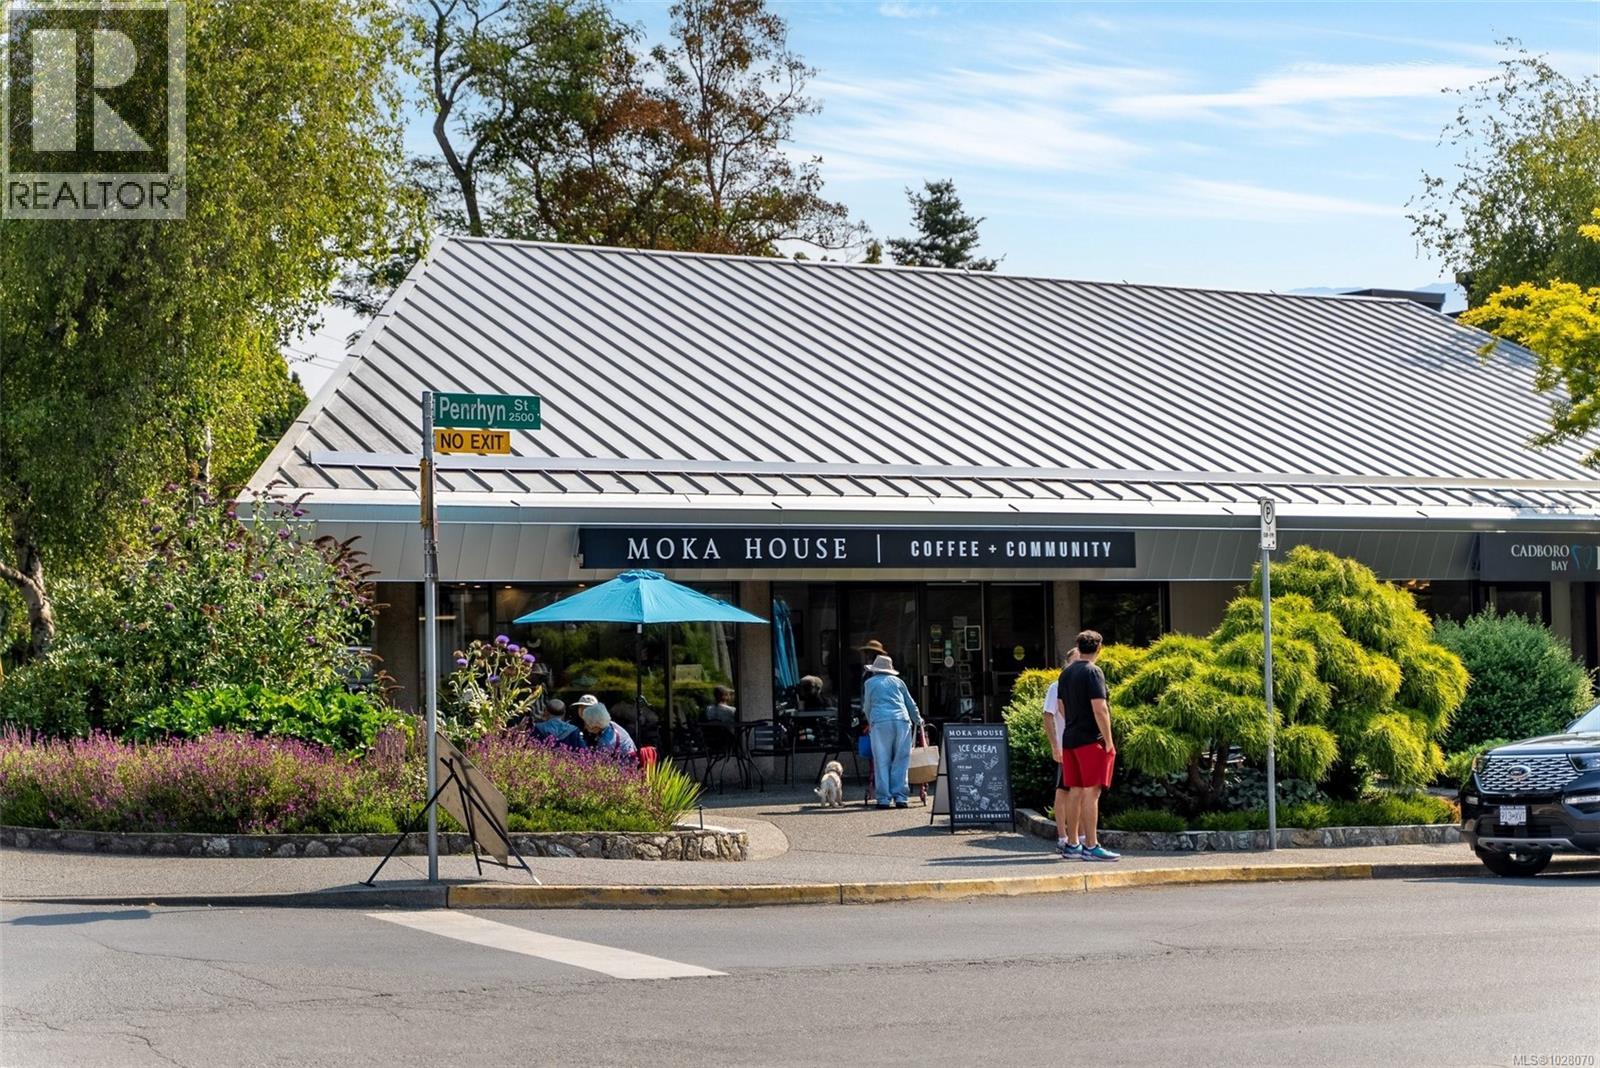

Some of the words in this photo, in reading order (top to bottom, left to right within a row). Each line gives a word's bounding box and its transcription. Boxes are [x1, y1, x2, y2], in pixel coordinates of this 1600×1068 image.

[440, 396, 506, 425] Penrhyn
[514, 399, 528, 411] St
[508, 412, 535, 422] 2500
[440, 433, 464, 449] NO
[471, 434, 504, 450] EXIT
[627, 537, 721, 560] MOKA
[745, 537, 848, 560] HOUSE
[910, 540, 980, 557] COFFEE
[1006, 541, 1112, 557] COMMUNITY
[1510, 544, 1570, 557] CADBORO
[1551, 560, 1569, 571] BAY
[958, 744, 970, 753] ICE
[972, 744, 997, 754] CREAM
